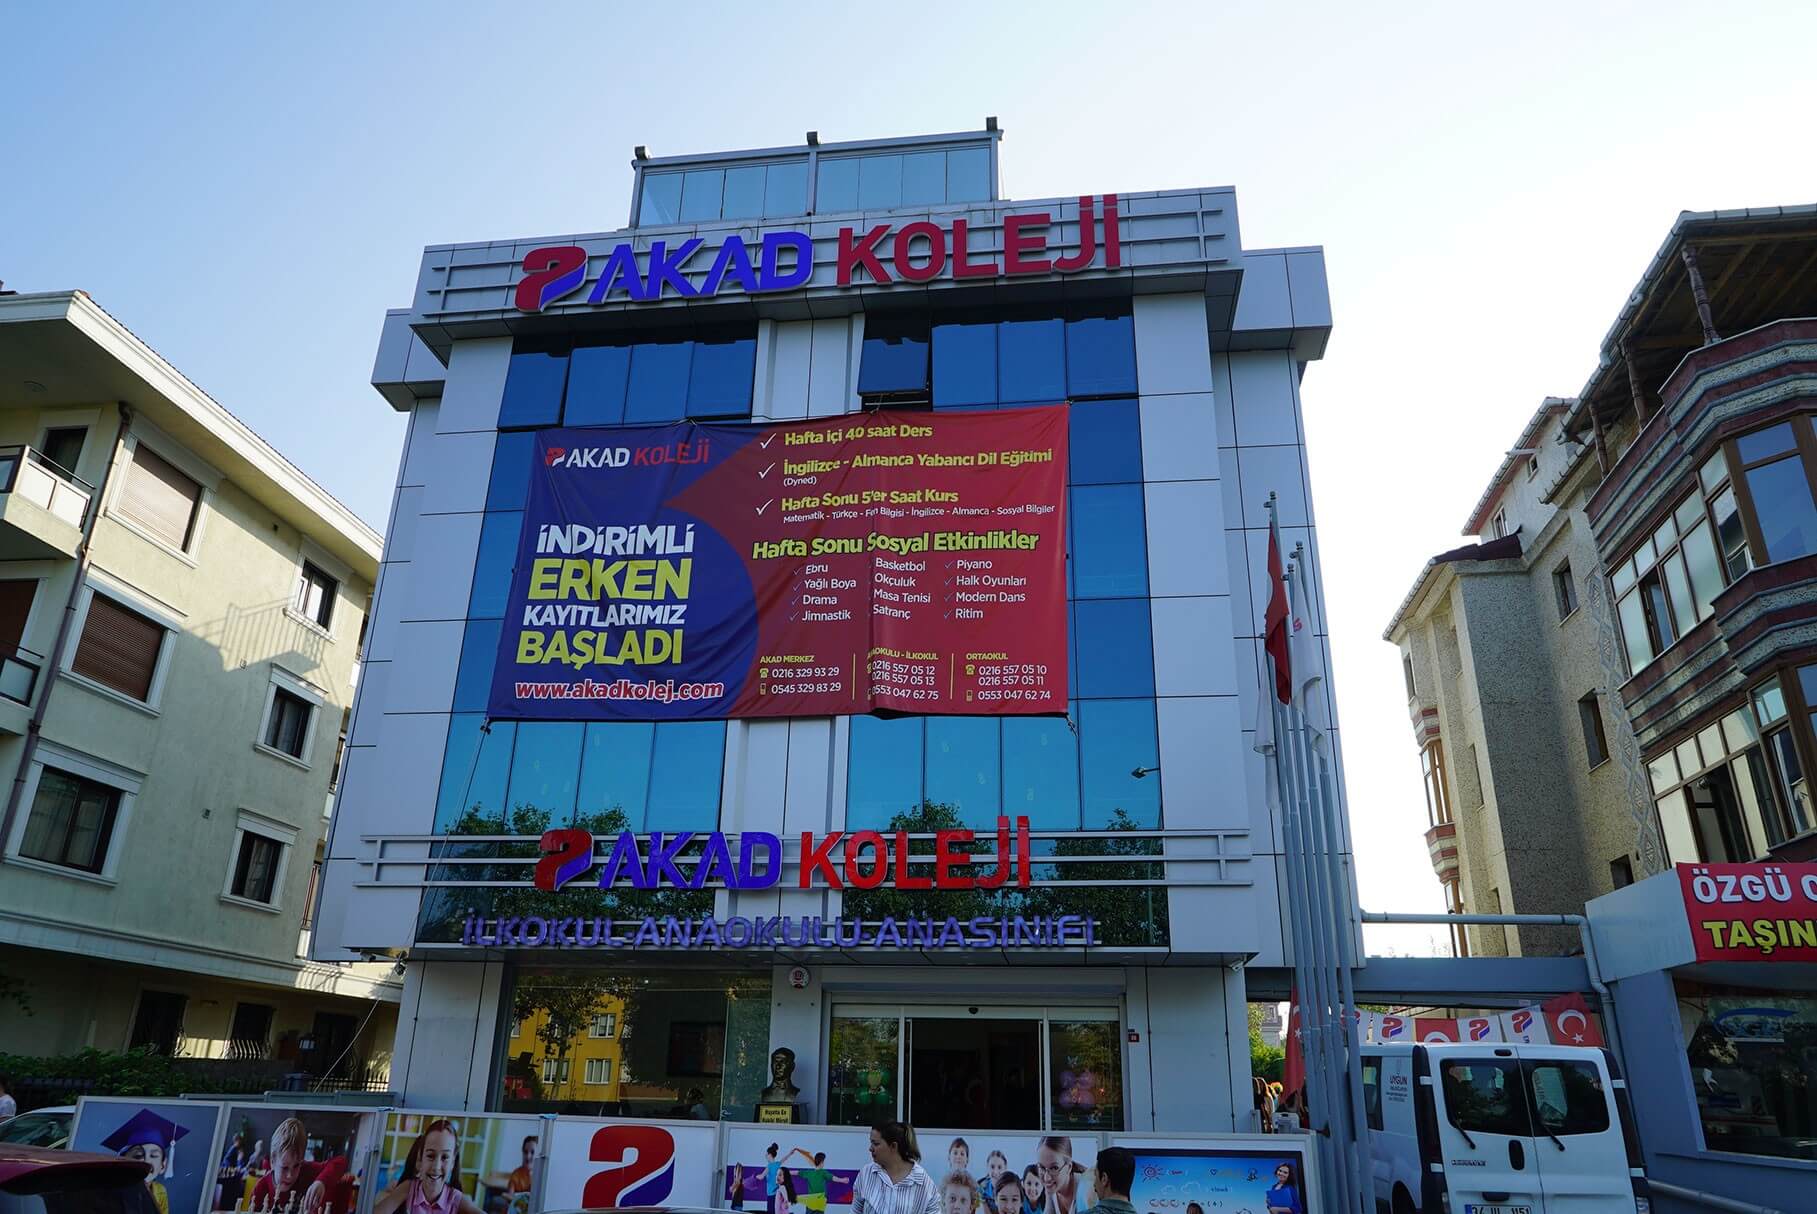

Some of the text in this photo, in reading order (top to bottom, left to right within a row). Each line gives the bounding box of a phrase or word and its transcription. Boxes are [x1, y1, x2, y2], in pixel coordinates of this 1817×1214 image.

[586, 193, 1121, 305] AKAD KOLEJİ
[785, 424, 933, 446] Hafta içi 40 saat Ders
[566, 439, 710, 468] AKAD KOLEJİ
[783, 459, 841, 476] İngilizce
[851, 454, 914, 468] Almanca
[917, 453, 975, 467] Yabancı
[977, 452, 998, 466] Dil
[1000, 448, 1053, 468] Eğitimi
[783, 475, 817, 487] (Dyned)
[781, 497, 820, 512] Hafta
[822, 492, 859, 506] Sonu
[889, 490, 922, 504] Saat
[925, 488, 959, 503] Kurs
[783, 511, 825, 524] Matematik
[832, 511, 858, 520] Türkçe
[951, 507, 990, 516] Almanca
[997, 505, 1024, 516] Sosyal
[1025, 504, 1055, 515] Bilgiler
[536, 523, 695, 556] İNDİRİMLİ
[752, 529, 1040, 560] Hafta Sonu Sosyal Etkinlikler
[805, 564, 829, 575] Ebru
[875, 557, 926, 572] Basketbol
[957, 559, 993, 571] Piyano
[527, 557, 693, 601] ERKEN
[804, 578, 857, 591] Yağlı Boya
[874, 572, 917, 588] Okçuluk
[956, 575, 1027, 587] Halk Oyunları
[802, 594, 838, 605] Drama
[873, 589, 932, 604] Masa Tenisi
[955, 592, 1026, 603] Modern Dans
[523, 604, 688, 628] KAYITLARIMIZ
[802, 609, 851, 621] Jimnastik
[872, 604, 912, 619] Satranç
[955, 608, 984, 619] Ritim
[516, 628, 684, 671] BAŞLADI
[965, 652, 1009, 661] ORTAOKUL
[760, 655, 815, 664] AKAD MERKEZ
[771, 666, 840, 678] 0216 329 93 29
[892, 663, 909, 674] 557
[911, 665, 924, 675] 05
[925, 665, 935, 675] 12
[978, 664, 1048, 676] 0216 557 05 10
[891, 673, 909, 684] 557
[910, 675, 923, 685] 05
[925, 676, 935, 686] 13
[978, 675, 1045, 686] 0216 557 05 11
[514, 679, 726, 704] www.akadkolej.com
[771, 681, 842, 695] 0545 329 83 29
[892, 687, 911, 698] 047
[912, 689, 926, 700] 62
[927, 690, 939, 700] 75
[977, 689, 1052, 701] 0553 047 62 74
[599, 815, 1032, 890] AKAD KOLEJİ
[1691, 866, 1793, 904] ÖZGÜ
